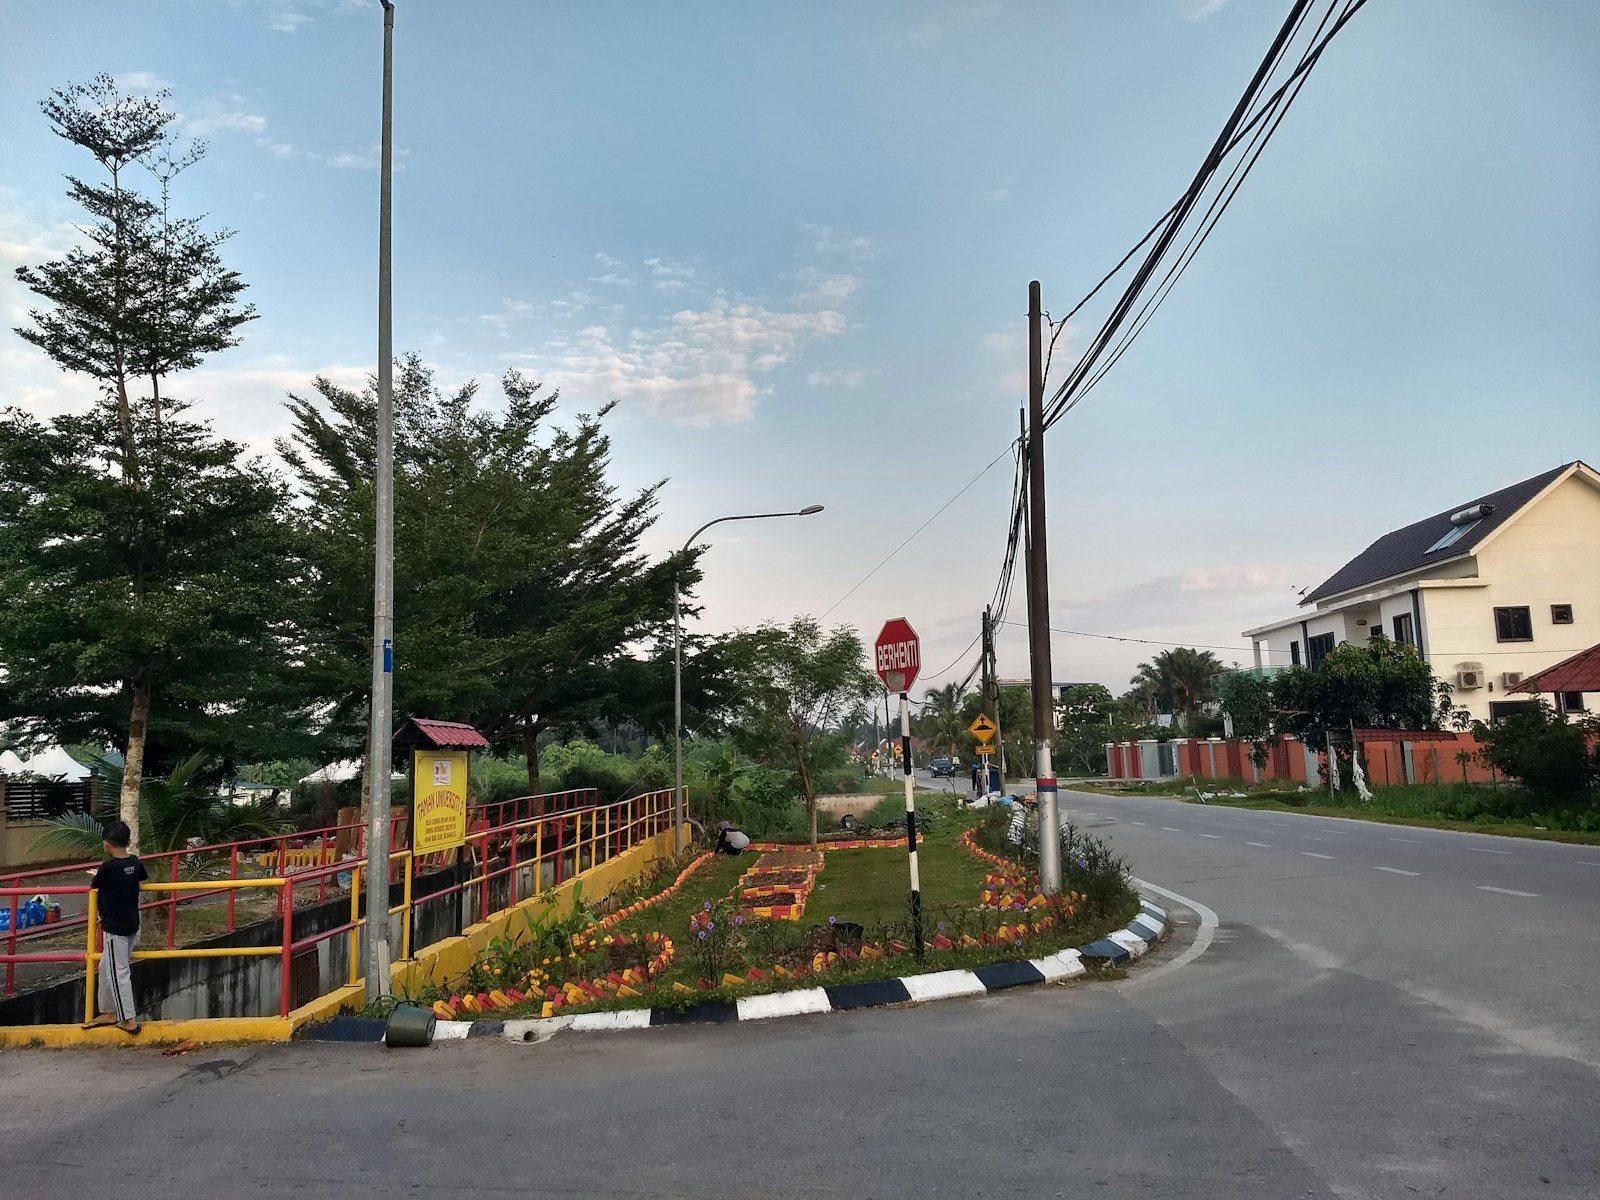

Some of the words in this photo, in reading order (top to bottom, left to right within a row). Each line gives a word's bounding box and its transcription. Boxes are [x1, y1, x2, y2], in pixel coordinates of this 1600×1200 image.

[877, 639, 918, 671] BERHENTI
[417, 791, 435, 821] TAMAN
[435, 789, 461, 813] UNIVERSITI
